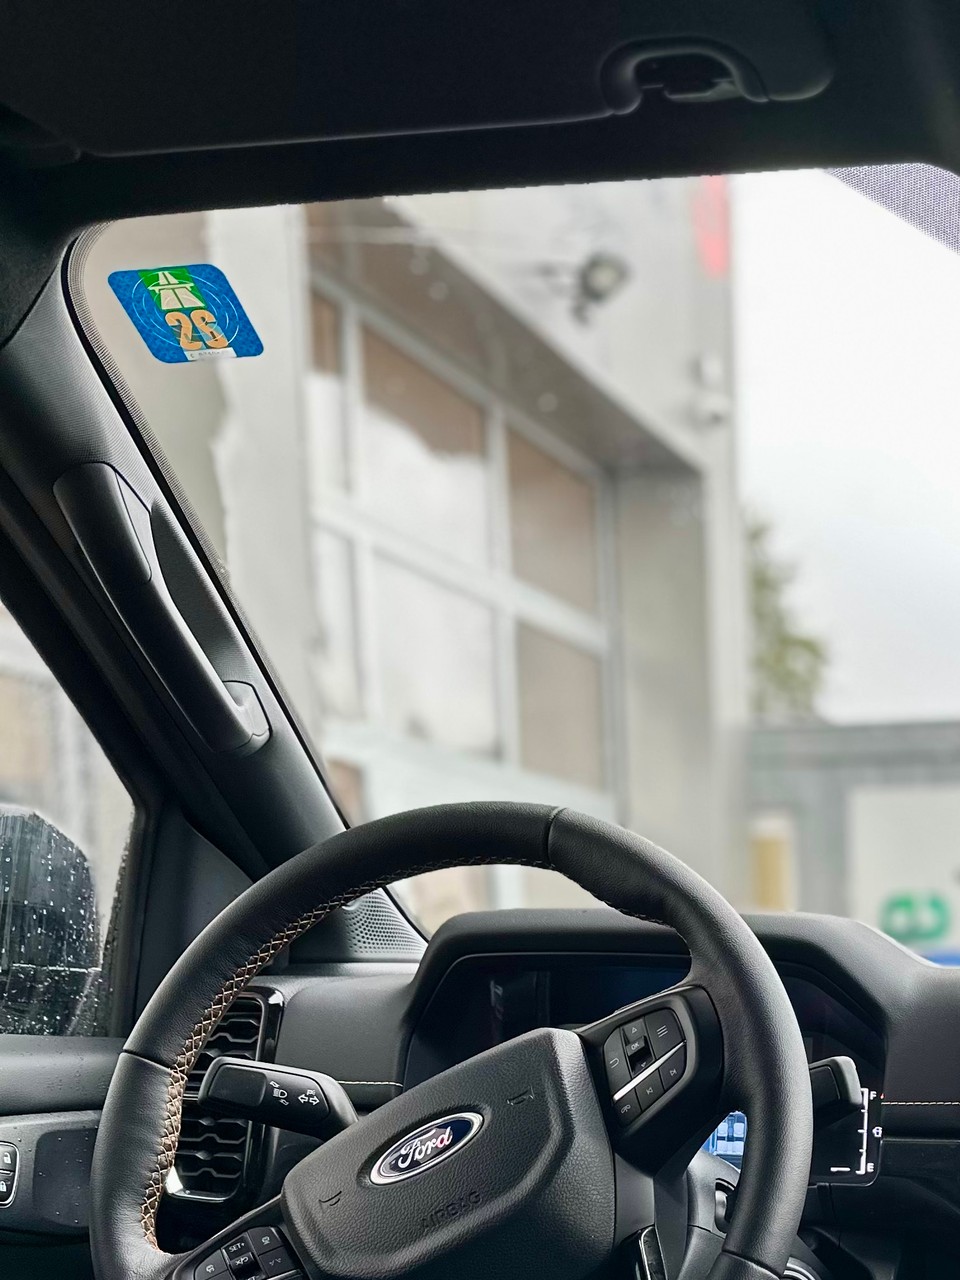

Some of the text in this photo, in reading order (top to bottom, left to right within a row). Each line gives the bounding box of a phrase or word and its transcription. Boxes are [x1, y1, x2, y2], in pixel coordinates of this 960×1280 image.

[631, 1041, 640, 1051] OK
[869, 1091, 877, 1100] F
[398, 1126, 453, 1169] Ford
[867, 1162, 875, 1172] E
